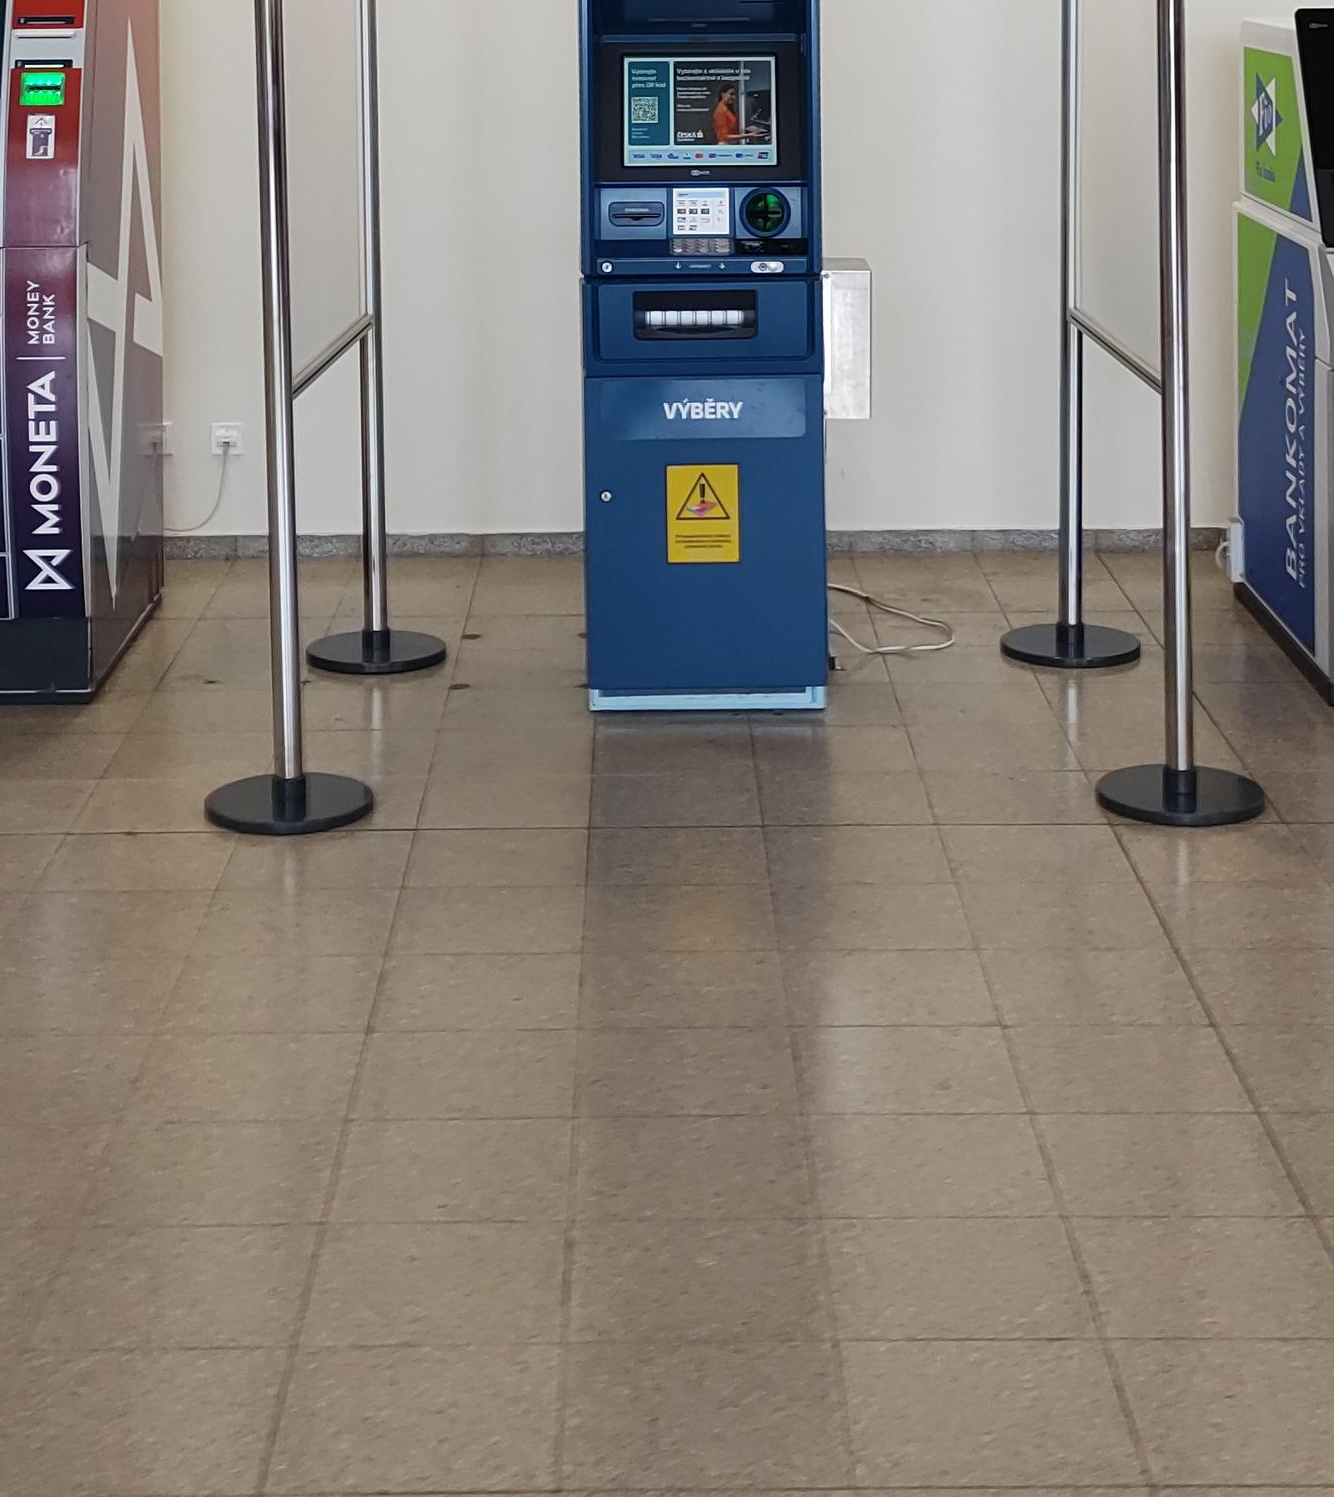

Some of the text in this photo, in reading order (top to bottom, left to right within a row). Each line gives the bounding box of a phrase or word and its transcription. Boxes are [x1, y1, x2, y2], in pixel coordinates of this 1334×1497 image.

[27, 280, 40, 345] MONEY
[42, 294, 55, 345] BANK
[663, 398, 744, 420] VÝBĚRY
[1285, 279, 1298, 581] BANKOMAT
[27, 371, 62, 535] MONETA
